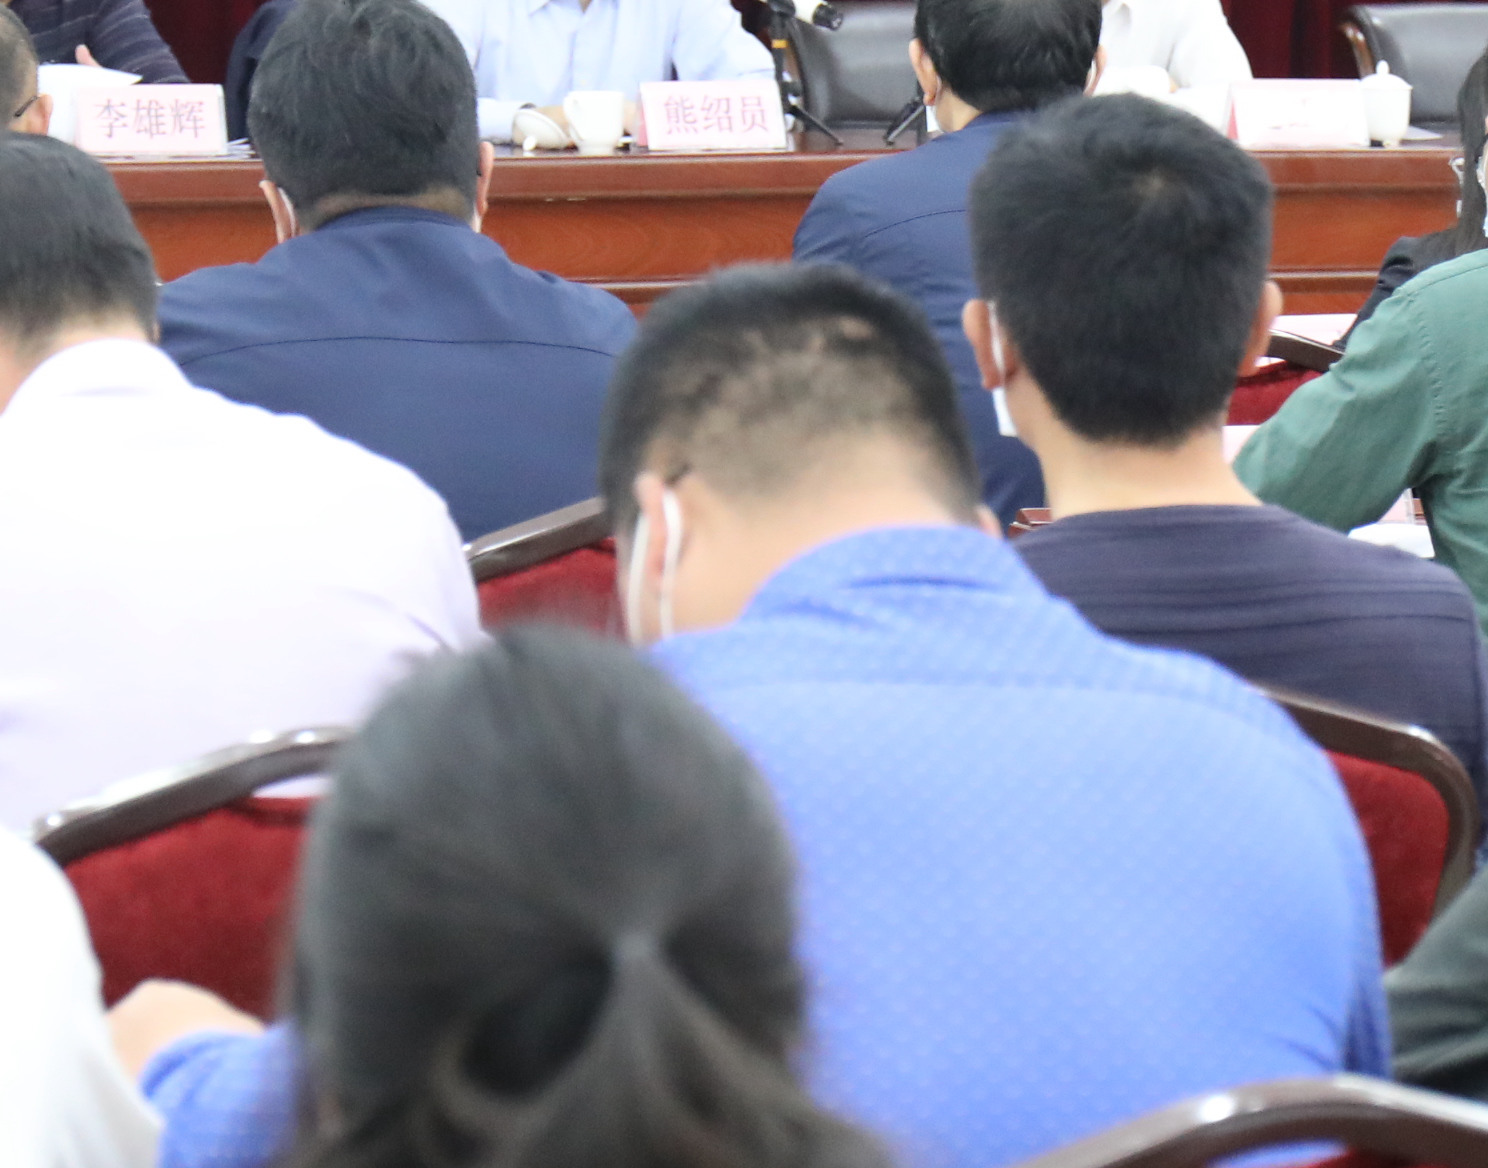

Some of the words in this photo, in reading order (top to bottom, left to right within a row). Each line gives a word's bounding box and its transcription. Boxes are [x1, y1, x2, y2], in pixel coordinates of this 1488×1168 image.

[95, 99, 206, 139] 李雄辉
[664, 95, 769, 135] 熊绍员
